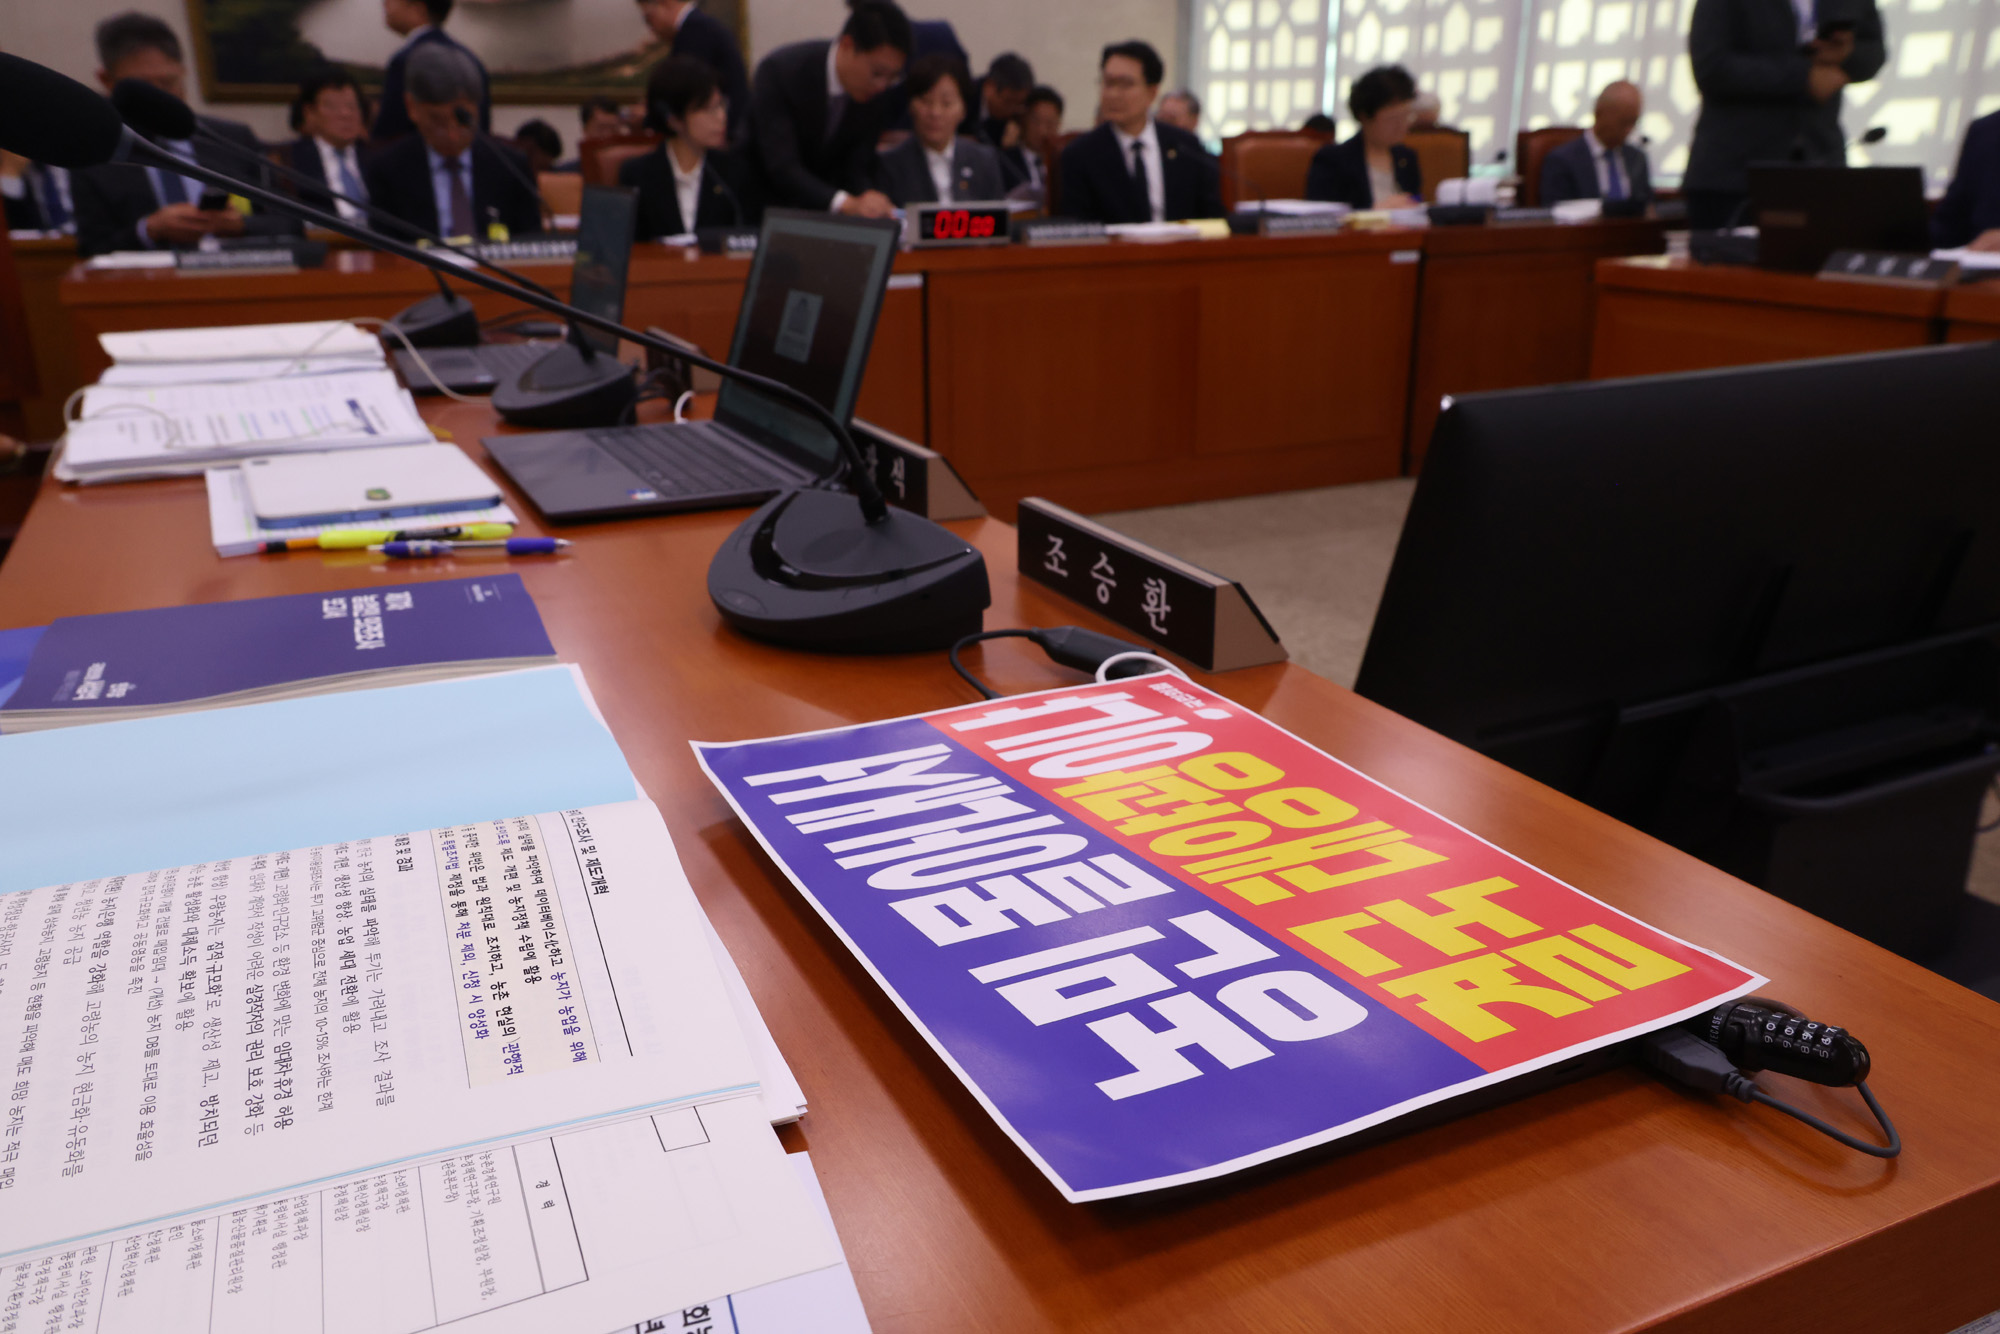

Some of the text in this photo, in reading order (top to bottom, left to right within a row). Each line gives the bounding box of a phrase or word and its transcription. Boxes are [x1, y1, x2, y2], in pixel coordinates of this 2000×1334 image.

[1044, 534, 1172, 635] 조 승 환
[467, 851, 485, 873] 위반은
[580, 844, 598, 855] 및
[357, 860, 375, 883] 농지의
[396, 856, 414, 872] 경과
[585, 857, 610, 895] 제도개혁
[950, 692, 1690, 1041] 결국 태양광이냐
[334, 873, 352, 897] 생산성
[447, 872, 465, 897] 제정을
[471, 875, 489, 892] 법과
[505, 883, 522, 893] 및
[182, 890, 202, 923] 활성화와
[359, 887, 377, 913] 실태를
[450, 900, 469, 918] 통해
[508, 896, 530, 930] 농지정책
[475, 896, 496, 931] 원칙대로
[744, 743, 1367, 1099] 농민 몰아내서
[67, 924, 87, 942] 농지
[246, 921, 265, 948] 작성이
[336, 926, 355, 946] 농업
[362, 917, 380, 947] 파악해
[455, 921, 472, 939] 처분
[62, 946, 83, 965] 공급
[90, 930, 112, 959] 역할을
[179, 926, 199, 966] 대체소득
[271, 943, 290, 954] 등
[311, 938, 326, 968] 중심으로
[485, 936, 504, 976] 조치하고,
[518, 934, 537, 961] 수립에
[246, 951, 264, 980] 어려운
[272, 956, 291, 977] 환경
[338, 950, 357, 970] 세대
[364, 952, 383, 982] 투기는
[29, 982, 46, 991] 등
[85, 962, 107, 995] 강화해
[127, 976, 143, 995] 촉진
[177, 969, 197, 1003] 확보에
[312, 969, 327, 987] 전체
[462, 970, 481, 989] 신청
[522, 964, 542, 985] 활용
[550, 971, 572, 1000] 농지가
[272, 979, 292, 1012] 변화에
[313, 989, 328, 1014] 농지의
[340, 974, 359, 1007] 전환에
[468, 994, 484, 1004] 시
[489, 980, 510, 1001] 농촌
[24, 994, 43, 1021] 현황을
[174, 1008, 195, 1032] 활용
[245, 984, 265, 1035] 실경작자의
[368, 988, 387, 1033] 가려내고
[558, 1005, 581, 1036] 농업을
[79, 1000, 102, 1045] 고령농의
[146, 1014, 162, 1033] 농지
[201, 1016, 222, 1051] 생산성
[273, 1014, 292, 1037] 맞는
[342, 1010, 361, 1034] 활용
[467, 1008, 490, 1039] 양성화
[495, 1005, 517, 1037] 현실의
[18, 1023, 38, 1053] 파악해
[245, 1038, 265, 1062] 권리
[373, 1040, 392, 1062] 조사
[75, 1051, 96, 1076] 농지
[502, 1042, 524, 1076] 관행적
[569, 1041, 587, 1063] 위해
[142, 1062, 158, 1092] 토대로
[247, 1066, 264, 1091] 보호
[316, 1052, 332, 1088] 조사하는
[10, 1080, 30, 1101] 희망
[374, 1069, 395, 1106] 결과를
[139, 1095, 156, 1116] 이용
[244, 1093, 265, 1118] 강화
[317, 1090, 334, 1112] 한계
[5, 1105, 26, 1137] 농지는
[198, 1094, 220, 1147] 방치되던
[243, 1123, 264, 1136] 등
[273, 1104, 294, 1130] 허용
[134, 1119, 154, 1161] 효율성을
[438, 1158, 460, 1203] 관측본부장)
[478, 1151, 501, 1205] 농촌경제연구원
